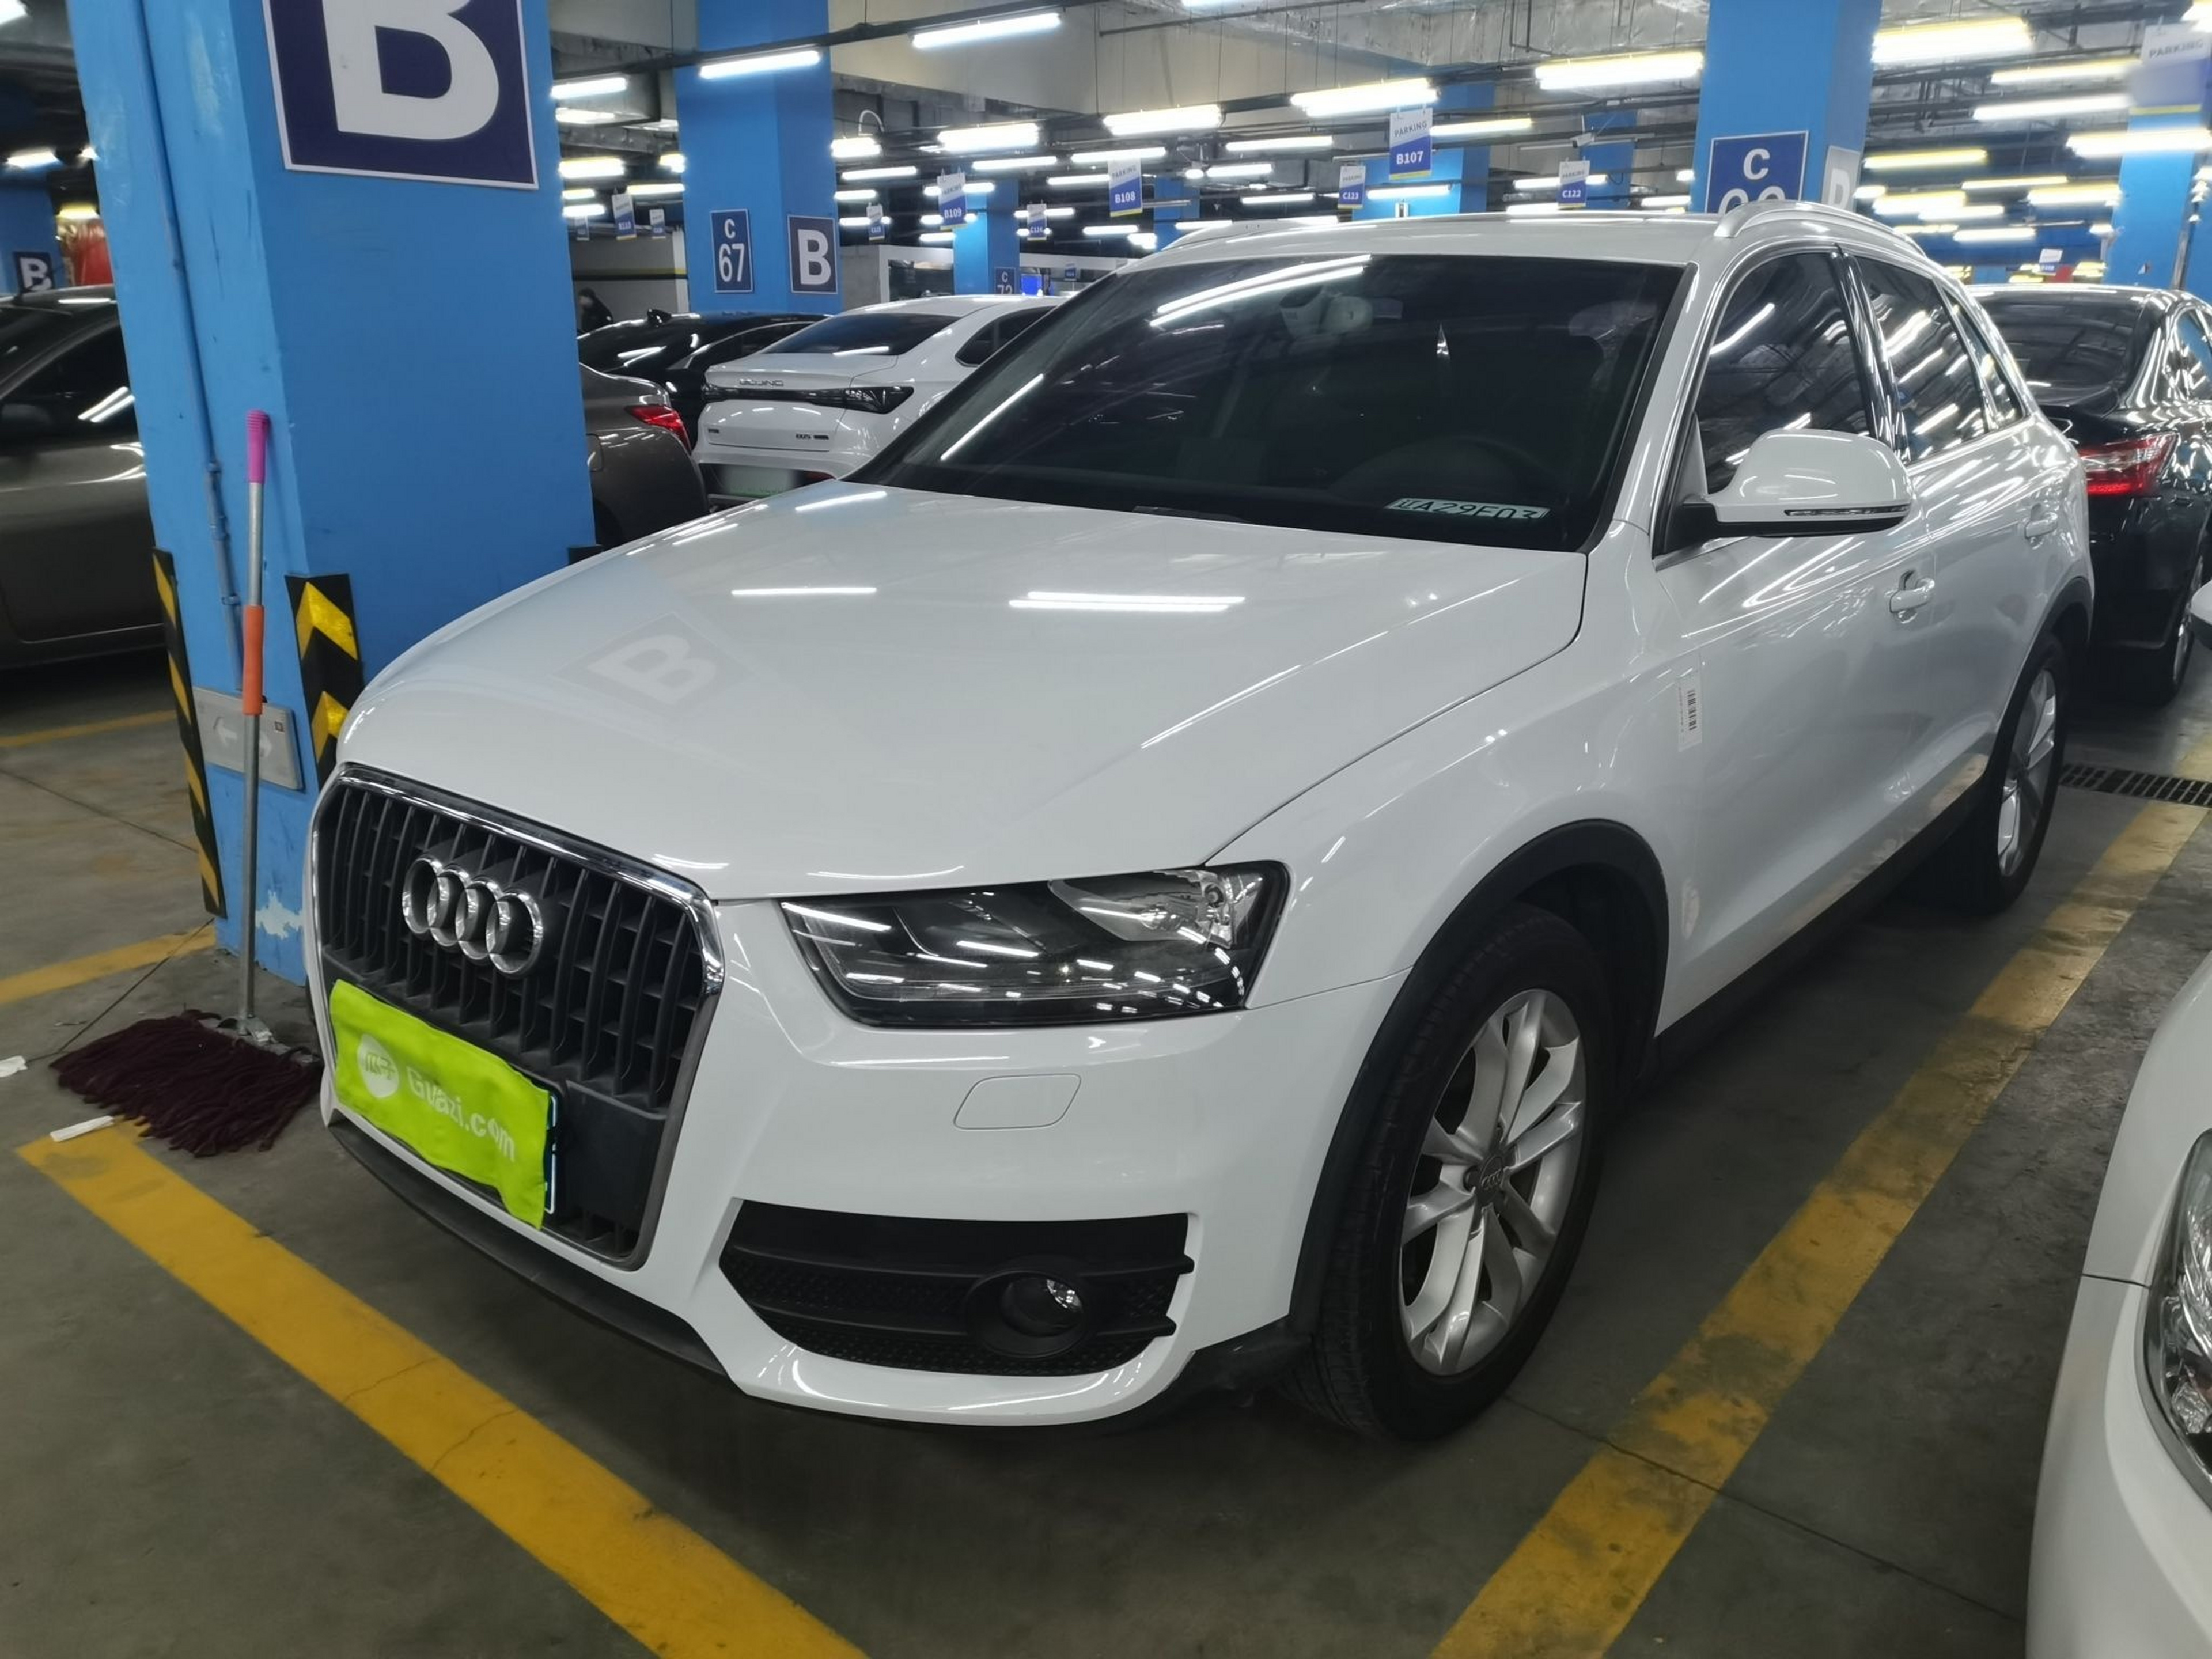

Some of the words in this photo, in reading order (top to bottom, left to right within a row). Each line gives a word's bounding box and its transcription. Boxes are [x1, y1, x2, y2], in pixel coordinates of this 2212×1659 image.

[2149, 39, 2204, 58] PARKING
[321, 0, 499, 140] B
[1394, 120, 1427, 137] PARKING
[1396, 151, 1423, 165] B107
[1743, 148, 1771, 180] C
[1115, 191, 1135, 203] B108
[1562, 190, 1581, 198] C122
[944, 207, 962, 219] B109
[724, 219, 736, 239] C
[719, 243, 745, 282] 67
[798, 229, 831, 285] B
[20, 257, 52, 291] B
[1002, 271, 1008, 283] C
